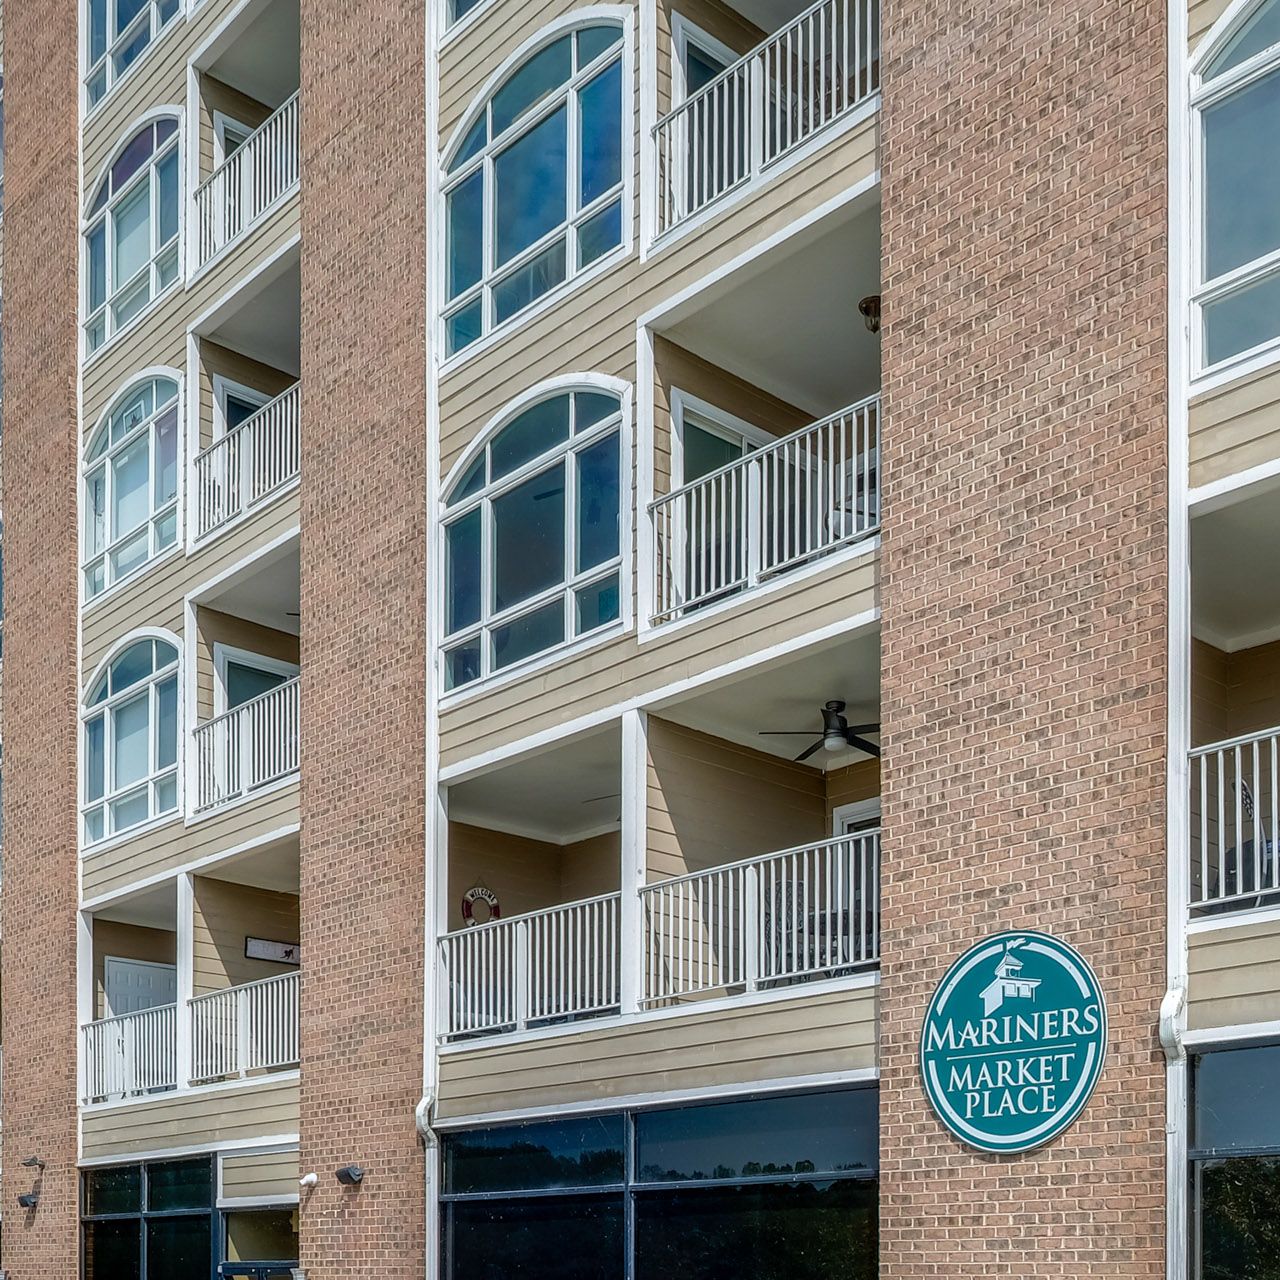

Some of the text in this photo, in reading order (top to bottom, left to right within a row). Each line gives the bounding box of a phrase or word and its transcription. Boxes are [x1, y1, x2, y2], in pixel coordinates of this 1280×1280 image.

[925, 1004, 1098, 1052] MARINERS
[947, 1053, 1075, 1092] MARKET
[964, 1085, 1057, 1119] PLACE
